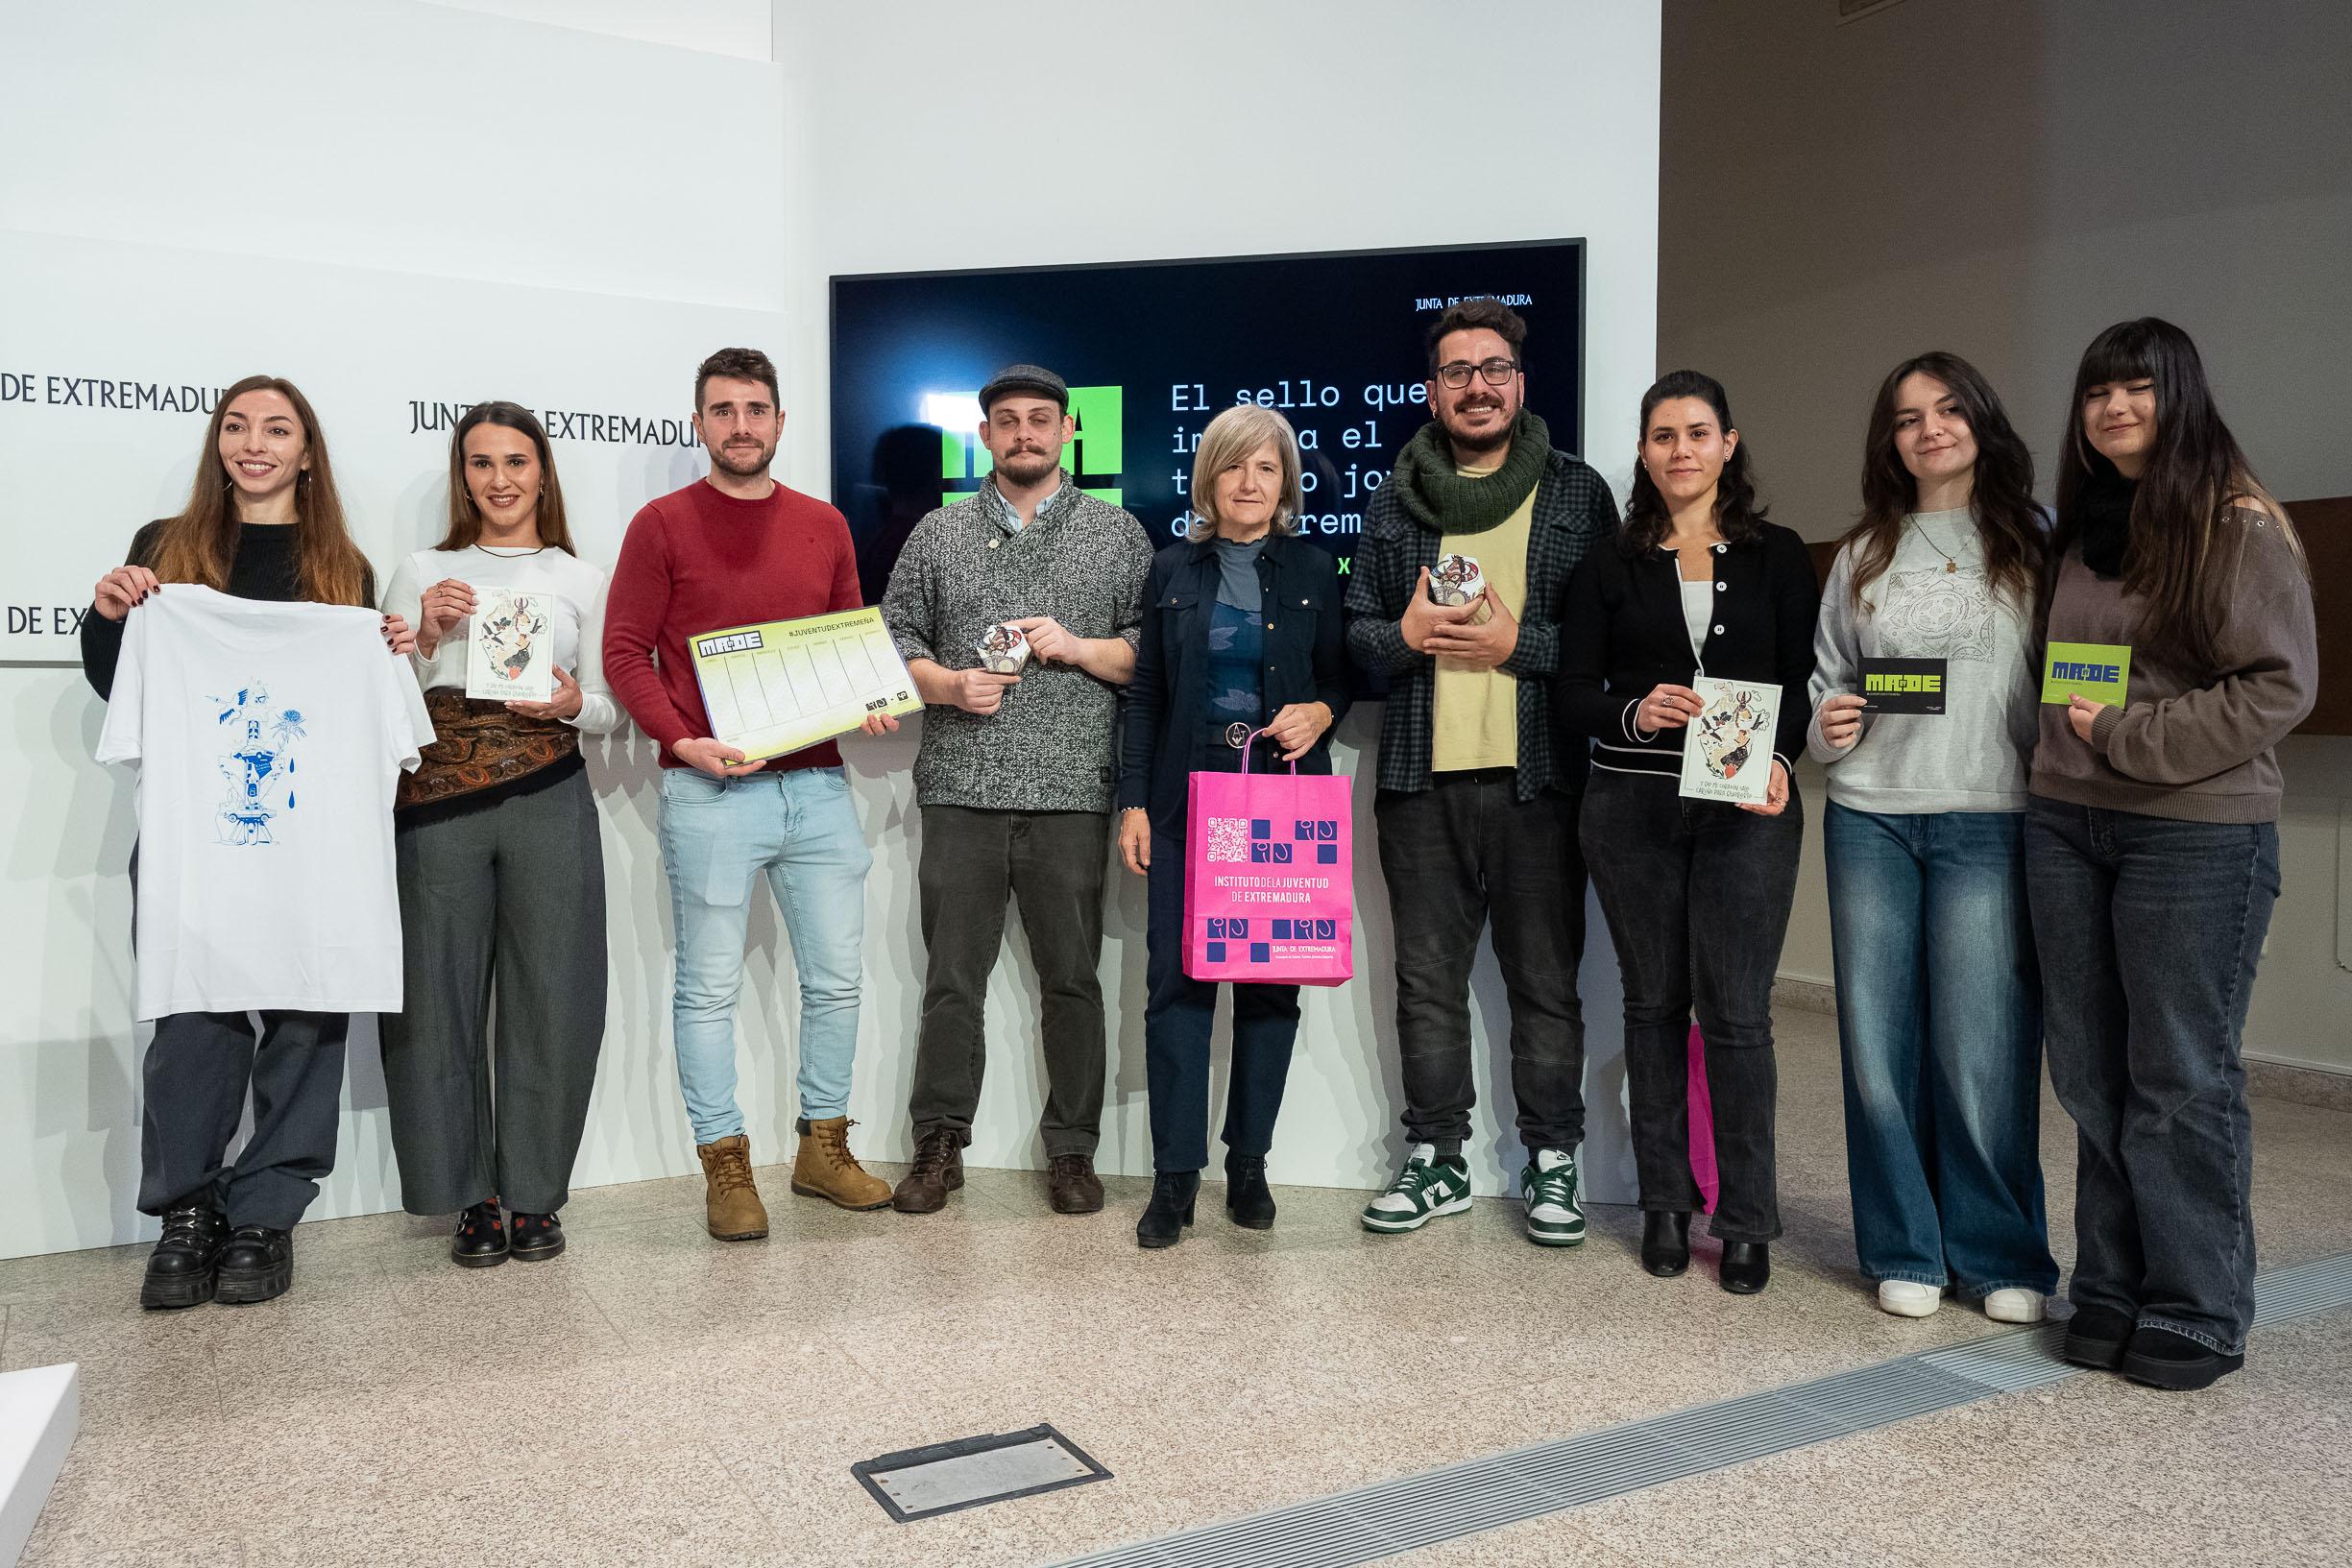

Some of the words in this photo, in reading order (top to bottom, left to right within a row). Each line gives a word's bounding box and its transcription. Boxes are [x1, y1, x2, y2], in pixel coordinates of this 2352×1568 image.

[1416, 298, 1443, 311] JUNTA
[1, 373, 36, 402] DE
[46, 375, 228, 415] EXTREMADU
[1173, 384, 1210, 411] El
[1235, 380, 1340, 408] sello
[1364, 383, 1427, 411] que
[545, 410, 701, 448] EXTREMADU
[1342, 421, 1382, 448] el
[8, 606, 43, 634] DE
[788, 616, 875, 637] #JUVENTUDEXTREMEÑA
[1231, 891, 1243, 903] DE
[1245, 891, 1311, 904] EXTREMADURA
